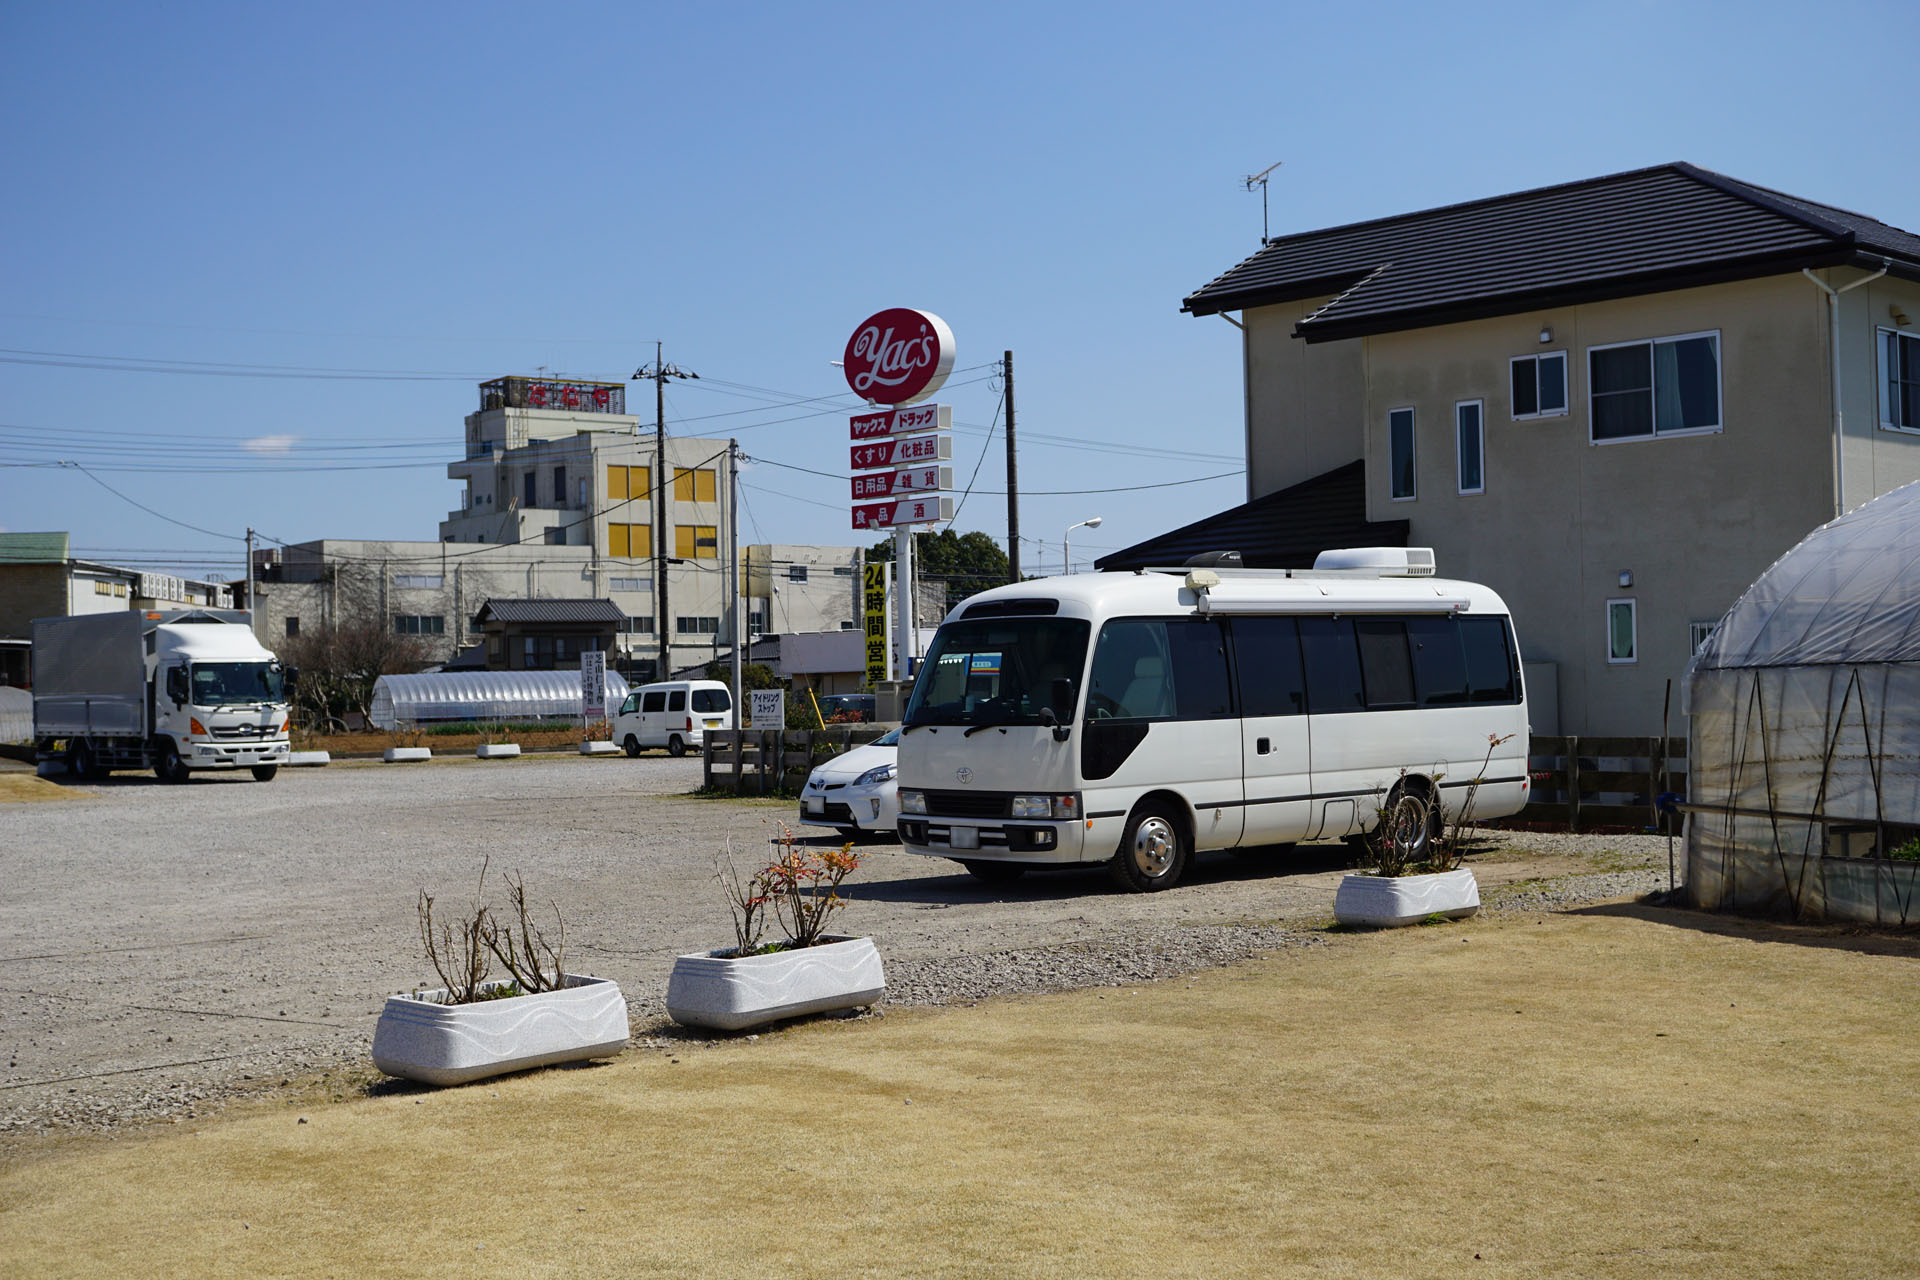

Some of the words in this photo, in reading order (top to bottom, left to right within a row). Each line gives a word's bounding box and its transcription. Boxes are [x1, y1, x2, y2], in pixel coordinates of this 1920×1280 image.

[853, 324, 934, 391] Yac's
[853, 418, 887, 434] ヤックス
[899, 409, 934, 428] ドラッグ
[854, 447, 887, 464] くすり
[901, 440, 935, 459] 化粧品
[855, 476, 887, 494] 日用品
[913, 503, 925, 518] 酒
[753, 693, 780, 703] アイドリング
[757, 703, 776, 713] ストップ
